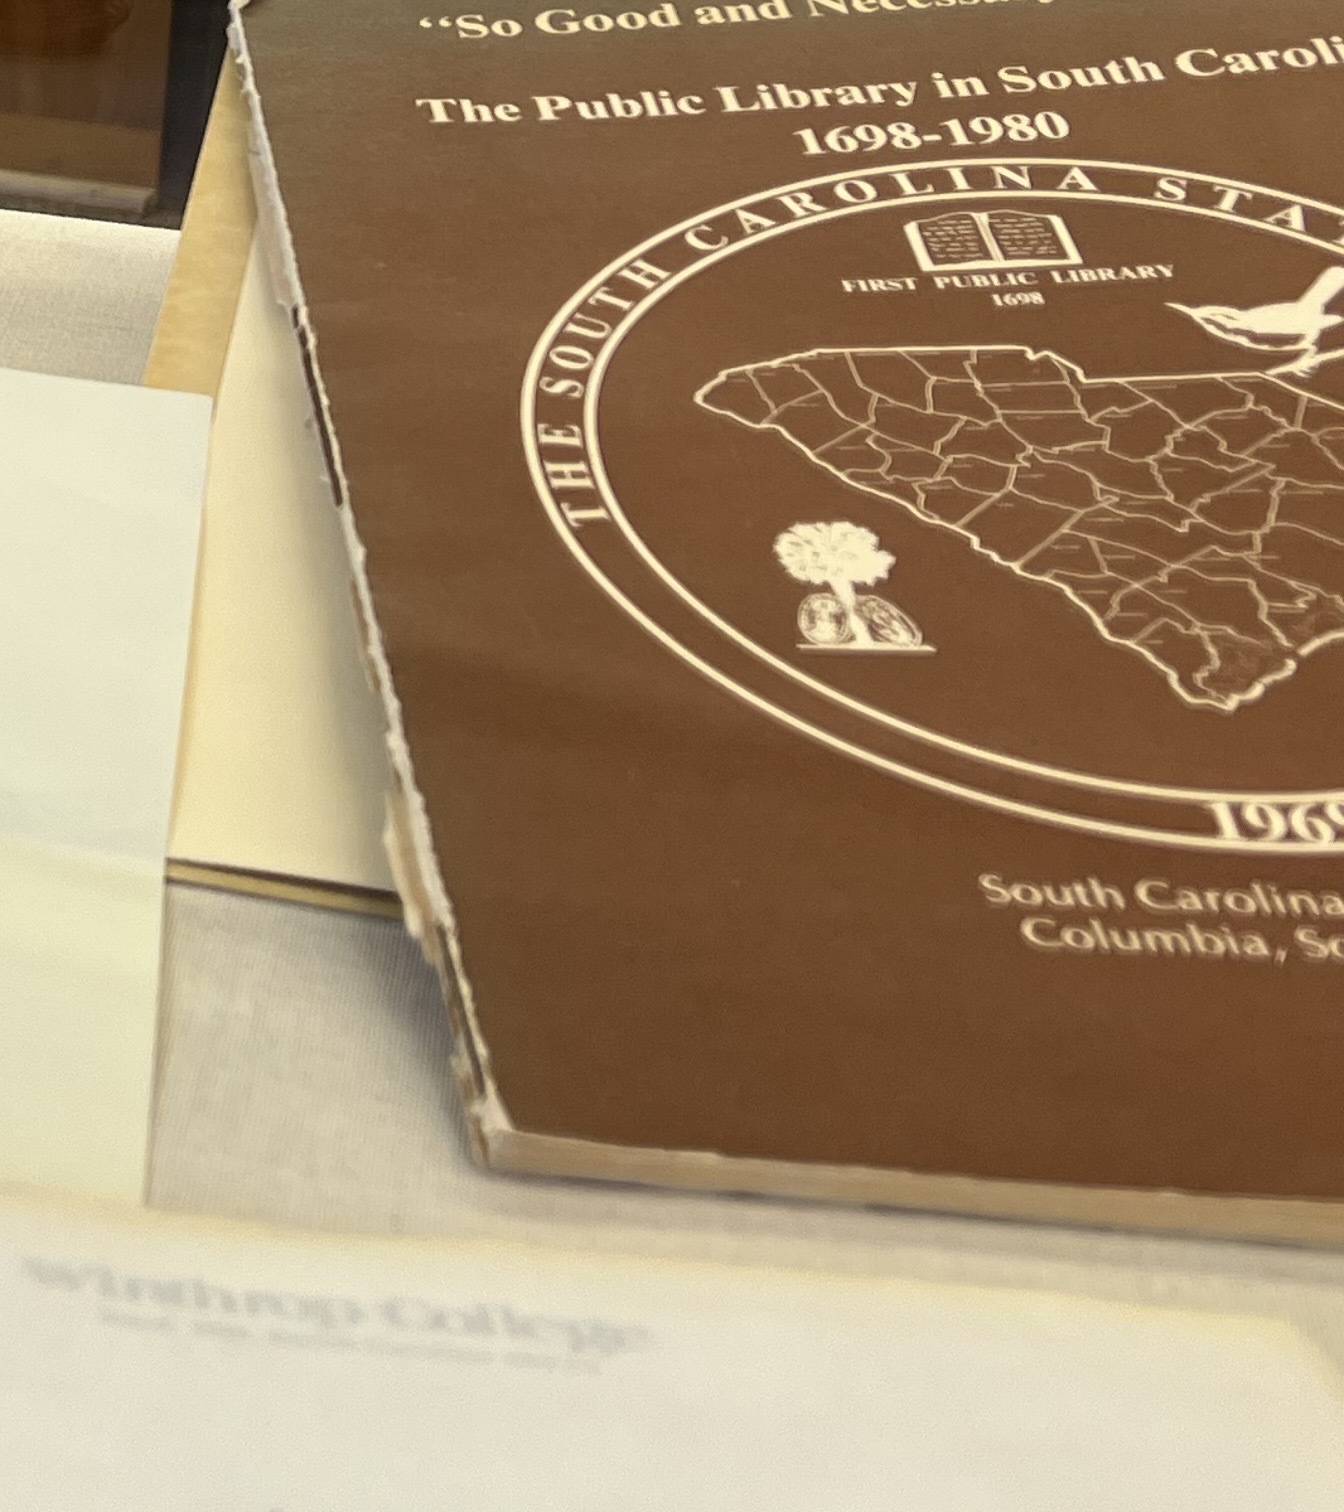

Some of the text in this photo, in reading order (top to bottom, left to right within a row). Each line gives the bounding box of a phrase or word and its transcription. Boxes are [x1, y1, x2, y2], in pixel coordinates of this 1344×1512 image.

[534, 2, 682, 36] Good
[415, 35, 1344, 124] The Public Library in South Caroli
[792, 110, 1070, 156] 1698-1980
[684, 165, 1098, 252] CAROLINA
[841, 264, 1174, 293] FIRST PUBLIC LIBRARY
[991, 291, 1046, 307] 1698
[540, 258, 670, 399] SOUTH
[539, 423, 612, 528] THE
[977, 873, 1126, 911] South
[1019, 915, 1288, 967] Columbia,
